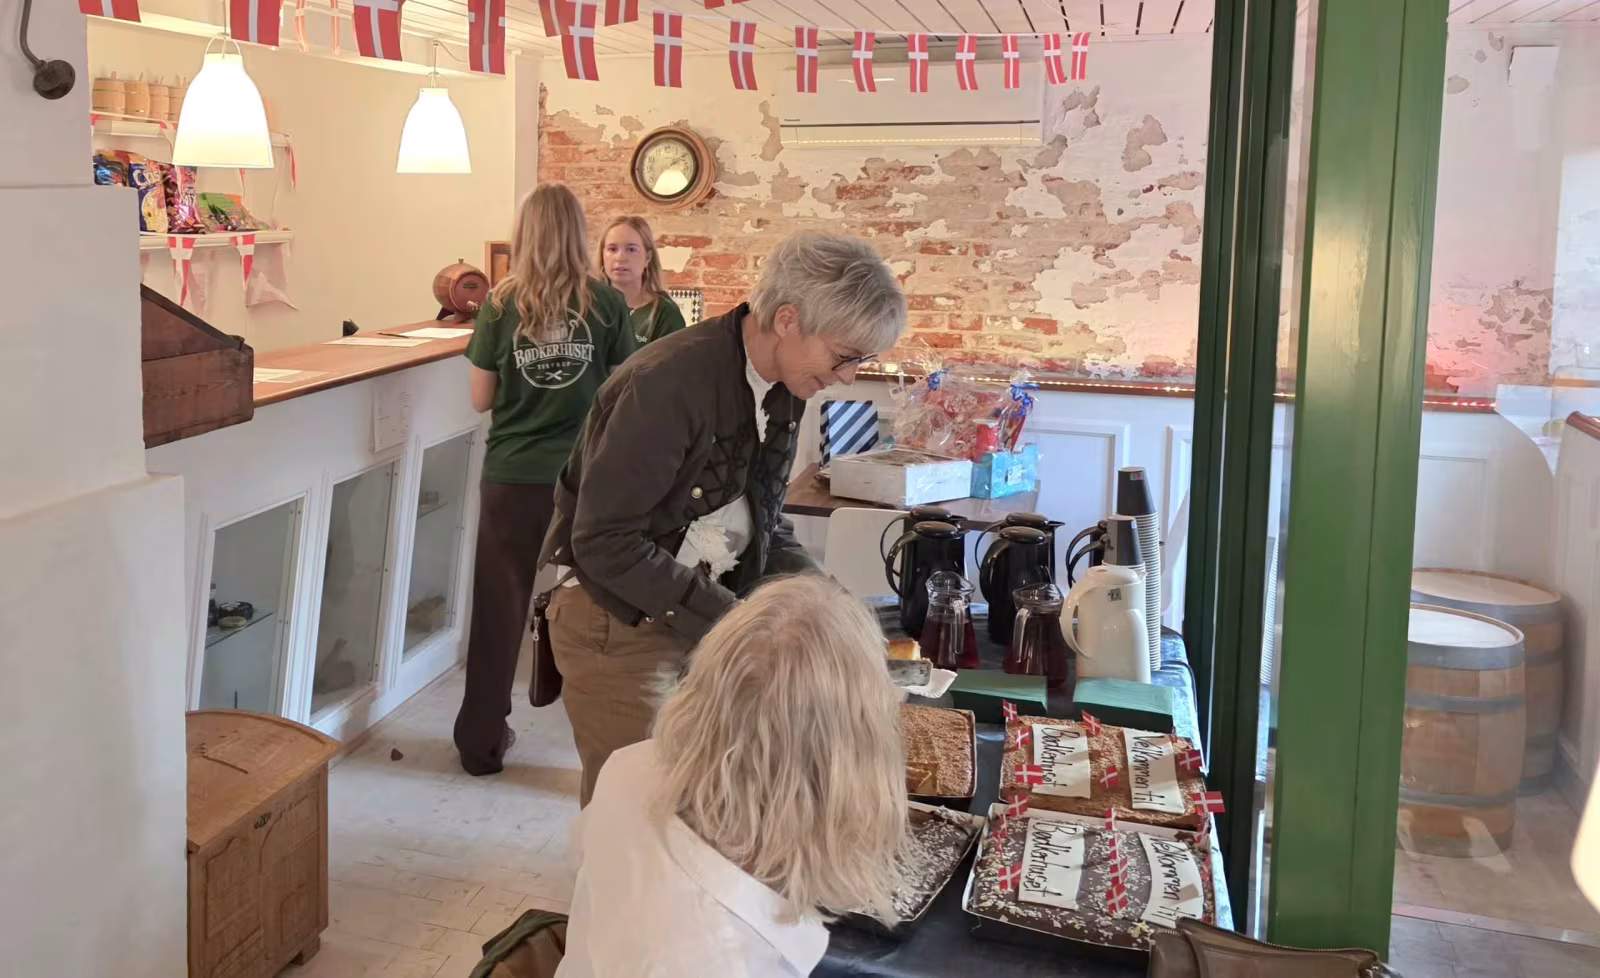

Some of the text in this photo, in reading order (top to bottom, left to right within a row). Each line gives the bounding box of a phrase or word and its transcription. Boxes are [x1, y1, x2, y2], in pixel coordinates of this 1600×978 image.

[513, 343, 595, 368] BØDKERHUSET
[1131, 735, 1166, 805] Velkommen til
[1149, 837, 1197, 922] Velkommen til
